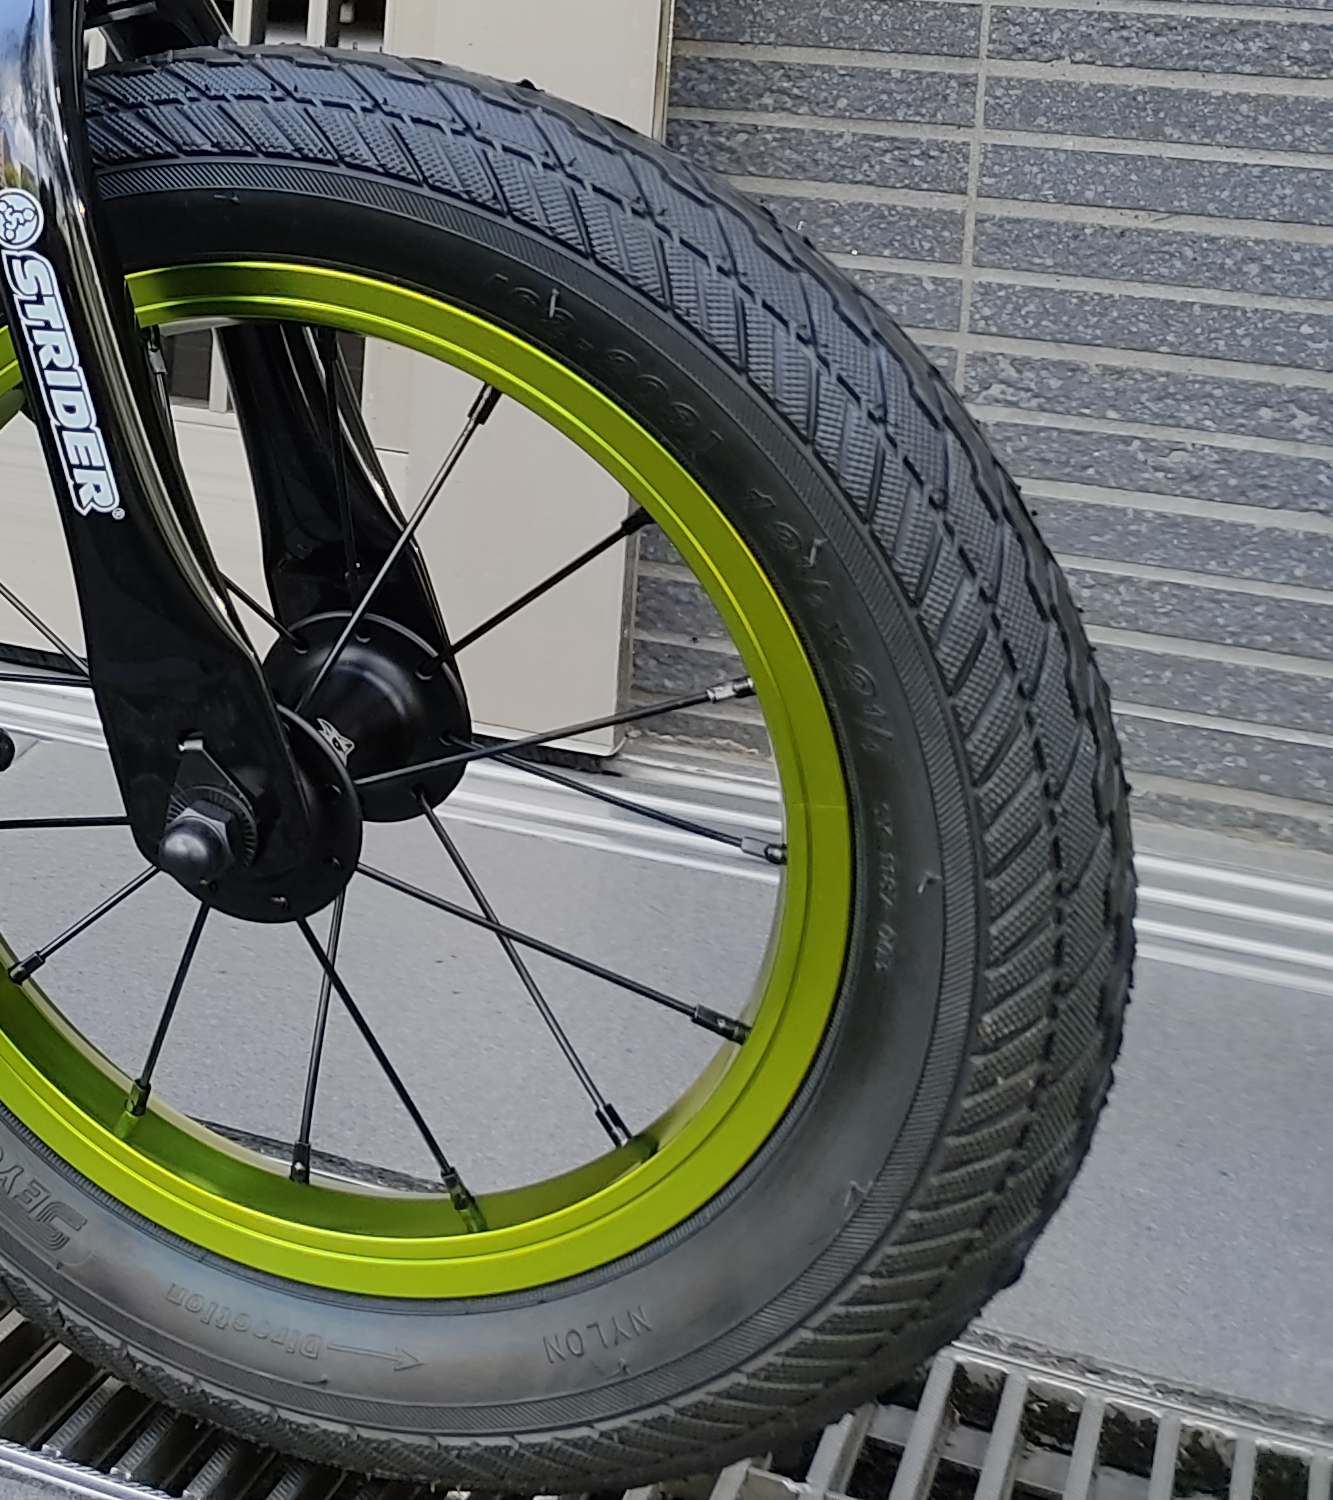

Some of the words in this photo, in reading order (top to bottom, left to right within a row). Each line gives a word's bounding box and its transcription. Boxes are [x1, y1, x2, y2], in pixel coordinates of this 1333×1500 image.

[2, 250, 120, 516] STRIDER
[165, 1283, 319, 1360] Direction
[542, 1306, 653, 1364] NYLON
